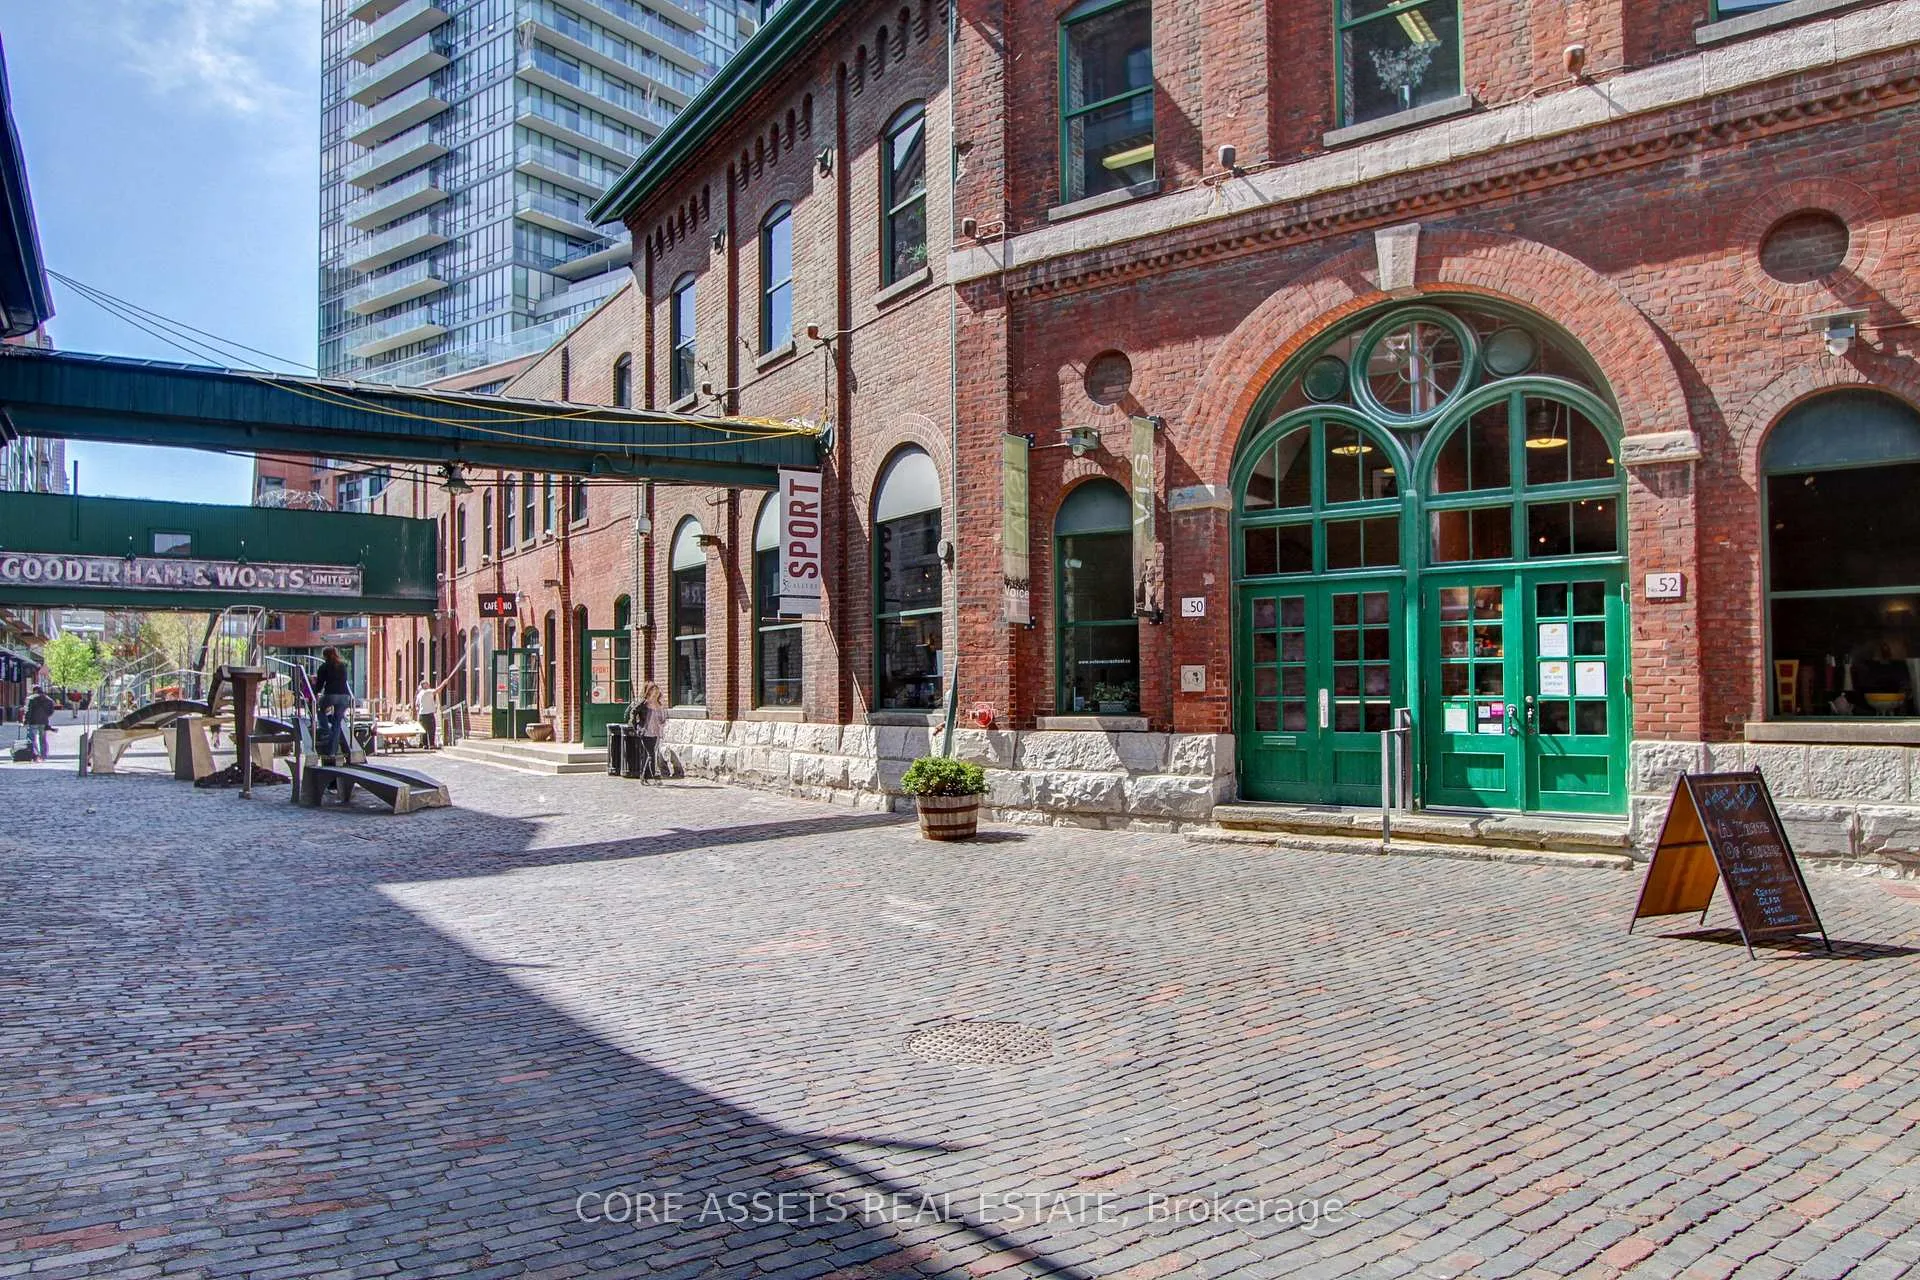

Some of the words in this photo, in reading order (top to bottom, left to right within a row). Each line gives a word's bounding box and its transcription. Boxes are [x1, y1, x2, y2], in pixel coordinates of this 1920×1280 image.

[788, 478, 819, 579] SPORT
[2, 557, 183, 585] GOODERHAM
[193, 566, 211, 586] &
[216, 566, 305, 588] WORTS
[310, 574, 352, 586] LIMITED
[1004, 585, 1029, 598] Voice
[1659, 577, 1678, 592] 52
[1190, 601, 1203, 613] 50
